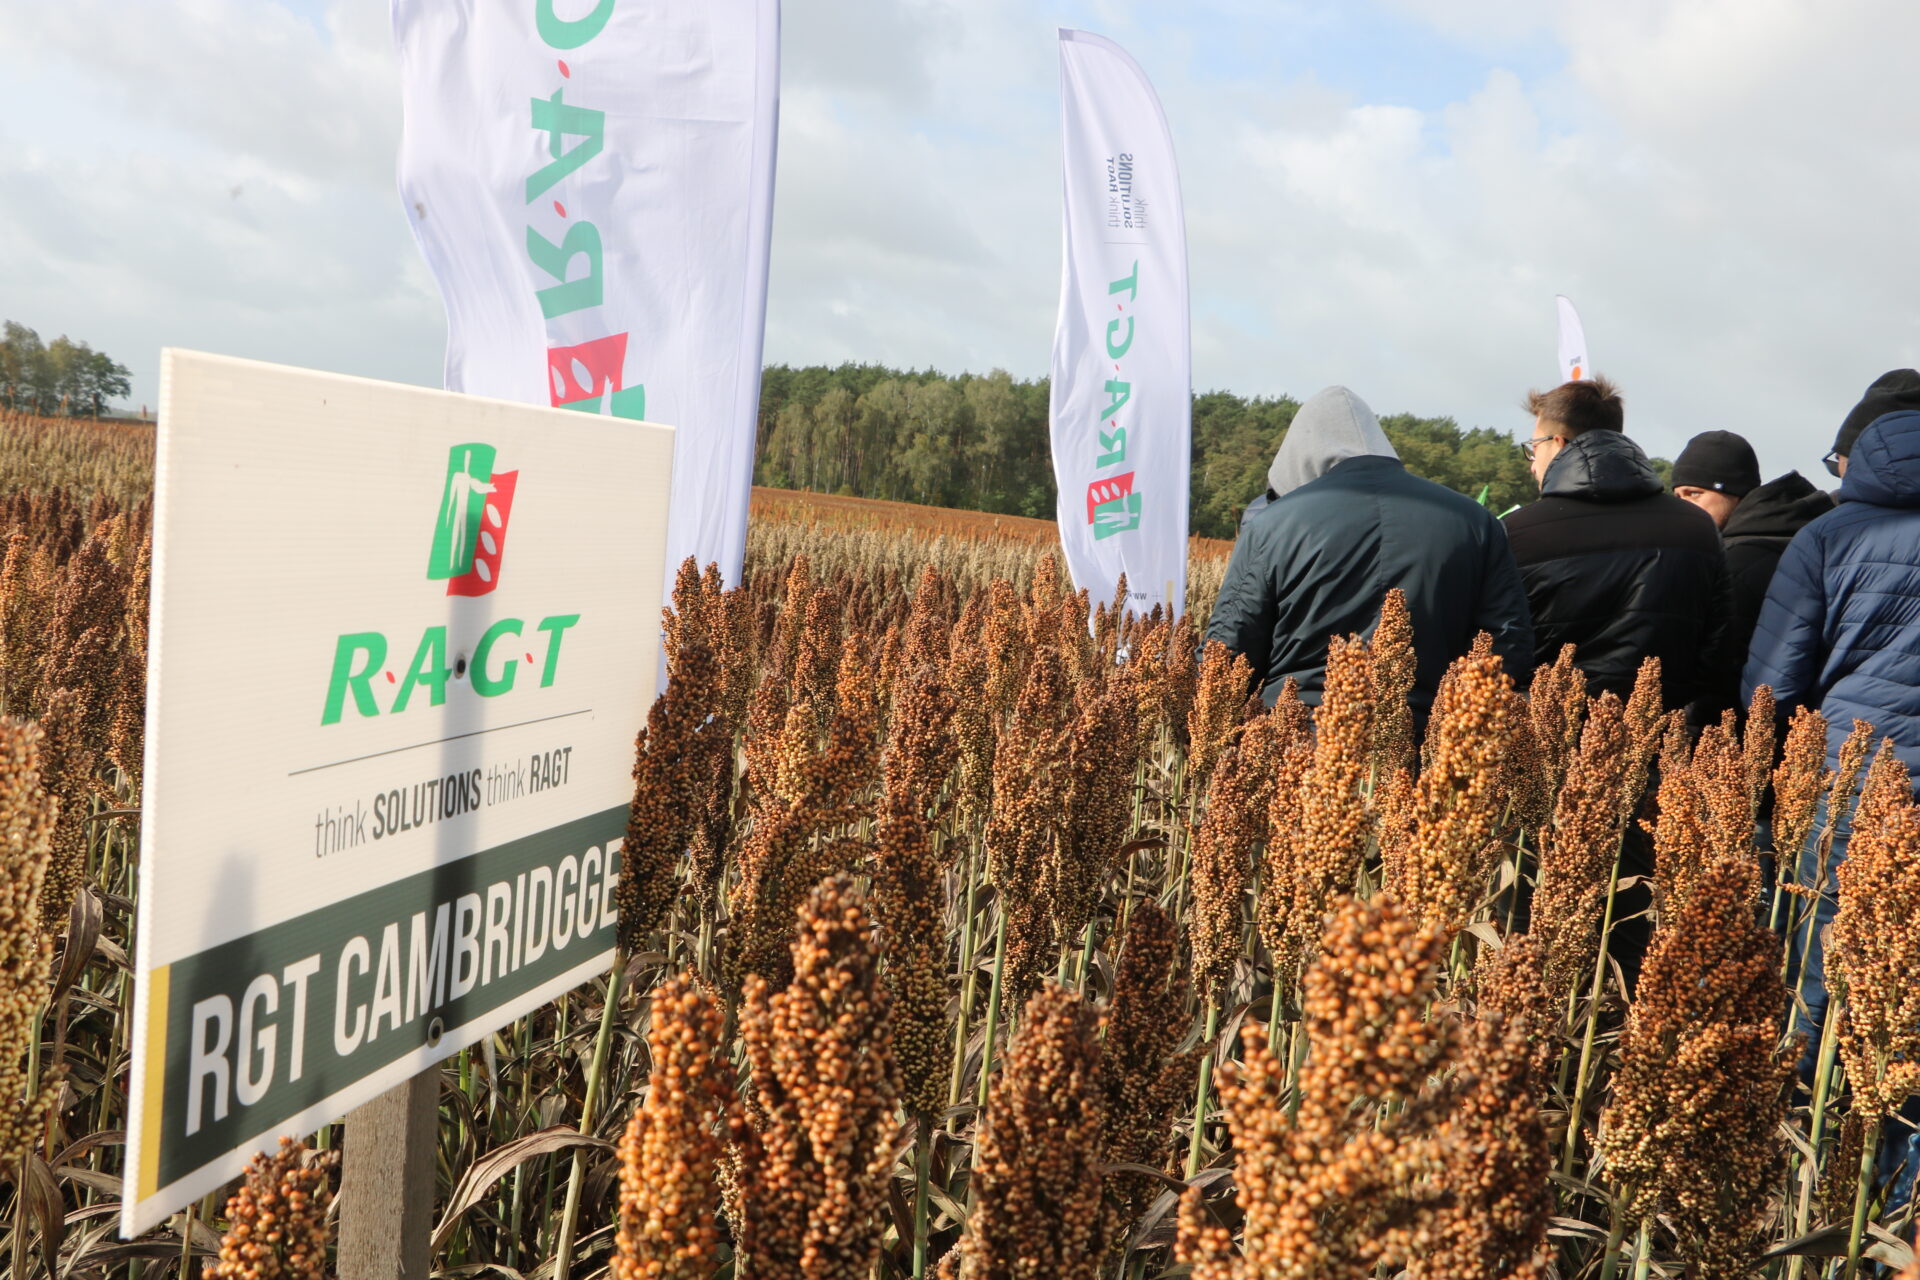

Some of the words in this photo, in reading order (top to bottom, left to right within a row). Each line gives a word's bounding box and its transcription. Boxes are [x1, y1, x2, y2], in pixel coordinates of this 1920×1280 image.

[320, 613, 582, 726] R·AG·T
[315, 799, 367, 858] think
[372, 768, 482, 840] SOLUTIONS
[486, 758, 527, 807] think
[529, 746, 572, 794] RAGT
[186, 953, 321, 1137] RGT
[334, 836, 625, 1057] CAMBRIDGGE
